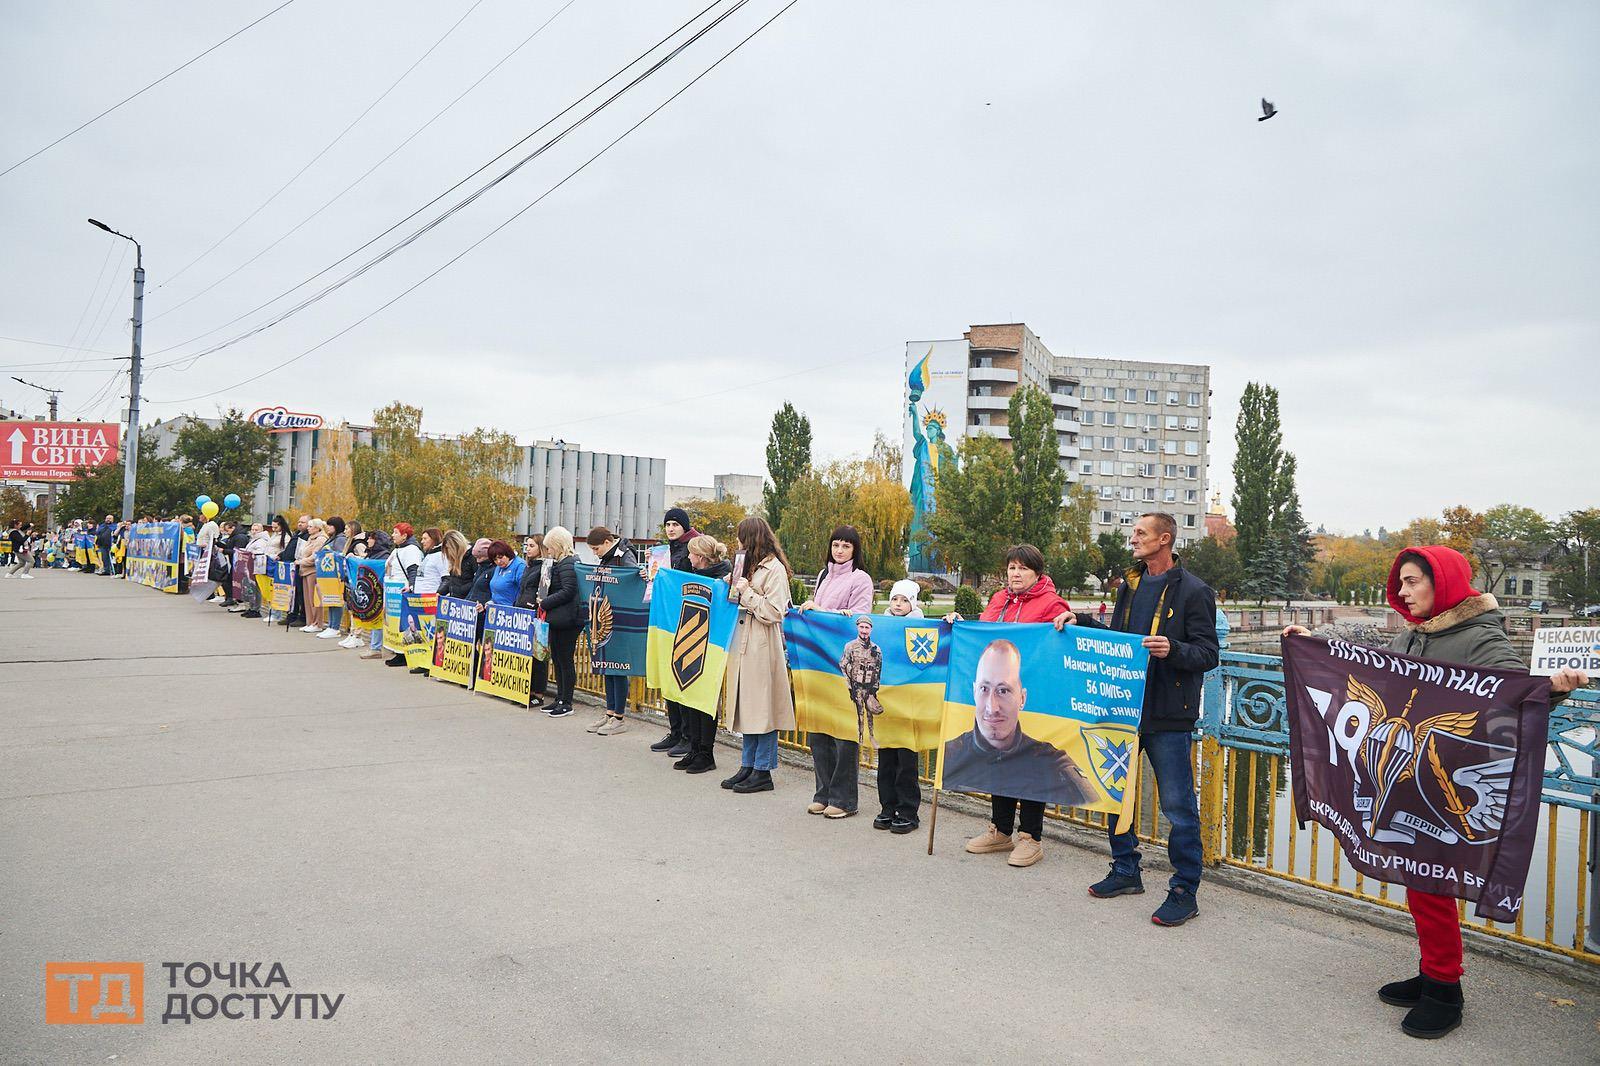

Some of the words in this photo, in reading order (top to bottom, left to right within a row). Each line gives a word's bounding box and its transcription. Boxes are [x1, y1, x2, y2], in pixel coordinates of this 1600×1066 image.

[257, 411, 319, 427] Сільпо
[32, 427, 110, 448] ВИНА
[31, 446, 110, 466] СВІТУ
[3, 469, 20, 477] вул.
[20, 469, 48, 477] Велика
[1075, 637, 1134, 660] ВЕРЧІНСЬКИЙ
[1548, 645, 1592, 654] НАШИХ
[1063, 654, 1098, 674] Максим
[1327, 638, 1386, 670] НІХТО
[1386, 654, 1445, 686] КРІМ
[1445, 667, 1505, 700] НАС!
[1537, 654, 1600, 670] ГЕРОЇВ
[1086, 678, 1098, 695] 56
[1070, 696, 1109, 717] Безвісти
[1404, 814, 1443, 837] ПЕРШІ
